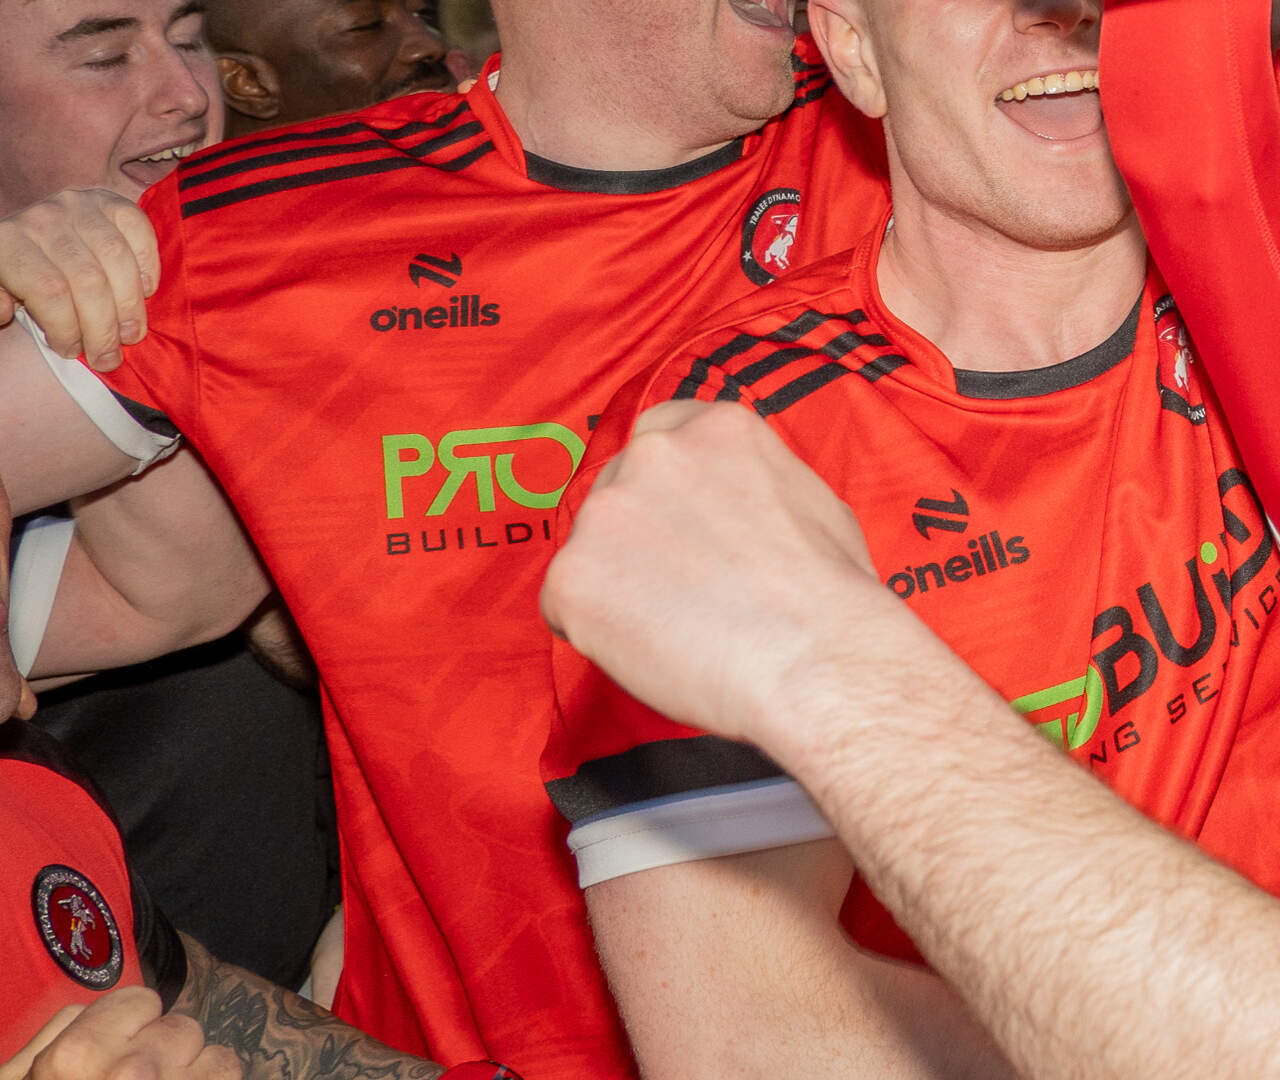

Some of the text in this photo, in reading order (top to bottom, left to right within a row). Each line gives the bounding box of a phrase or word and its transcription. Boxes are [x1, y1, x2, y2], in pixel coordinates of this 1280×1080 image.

[768, 192, 800, 204] DYNAMO
[370, 295, 500, 332] o'neills
[387, 520, 551, 555] BUILDI
